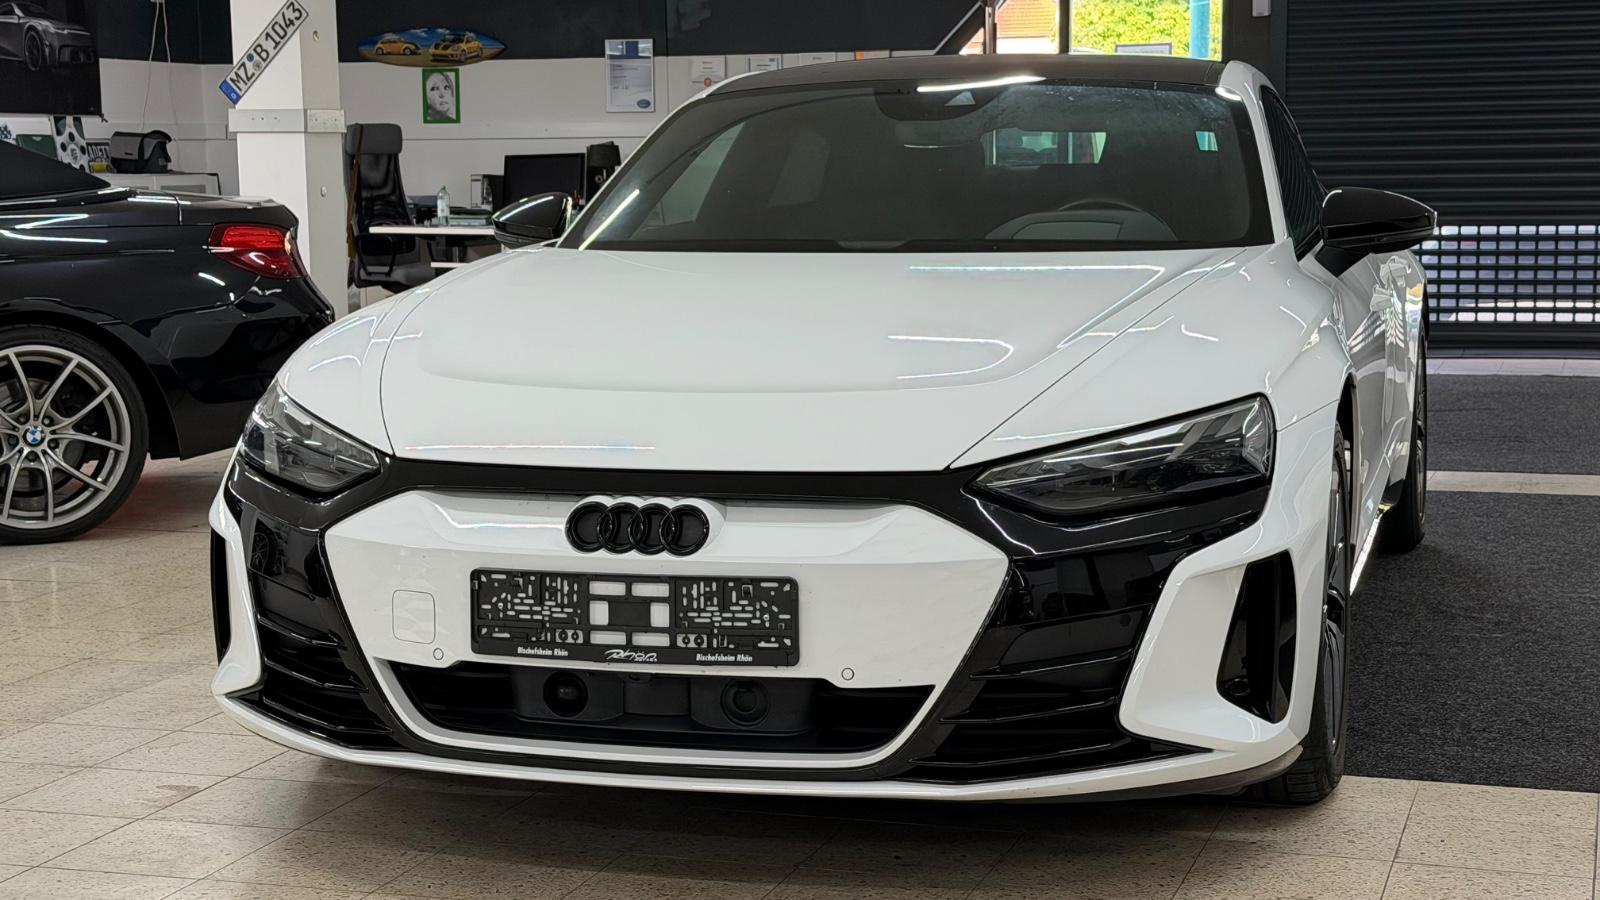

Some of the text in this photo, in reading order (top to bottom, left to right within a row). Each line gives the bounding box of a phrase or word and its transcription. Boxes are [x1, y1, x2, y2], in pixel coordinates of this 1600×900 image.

[229, 61, 255, 92] MZ
[253, 43, 270, 63] B
[265, 1, 303, 50] 1043
[517, 646, 569, 657] Bischofsheim Rhön
[696, 653, 753, 662] Bischofsheim Rhön
